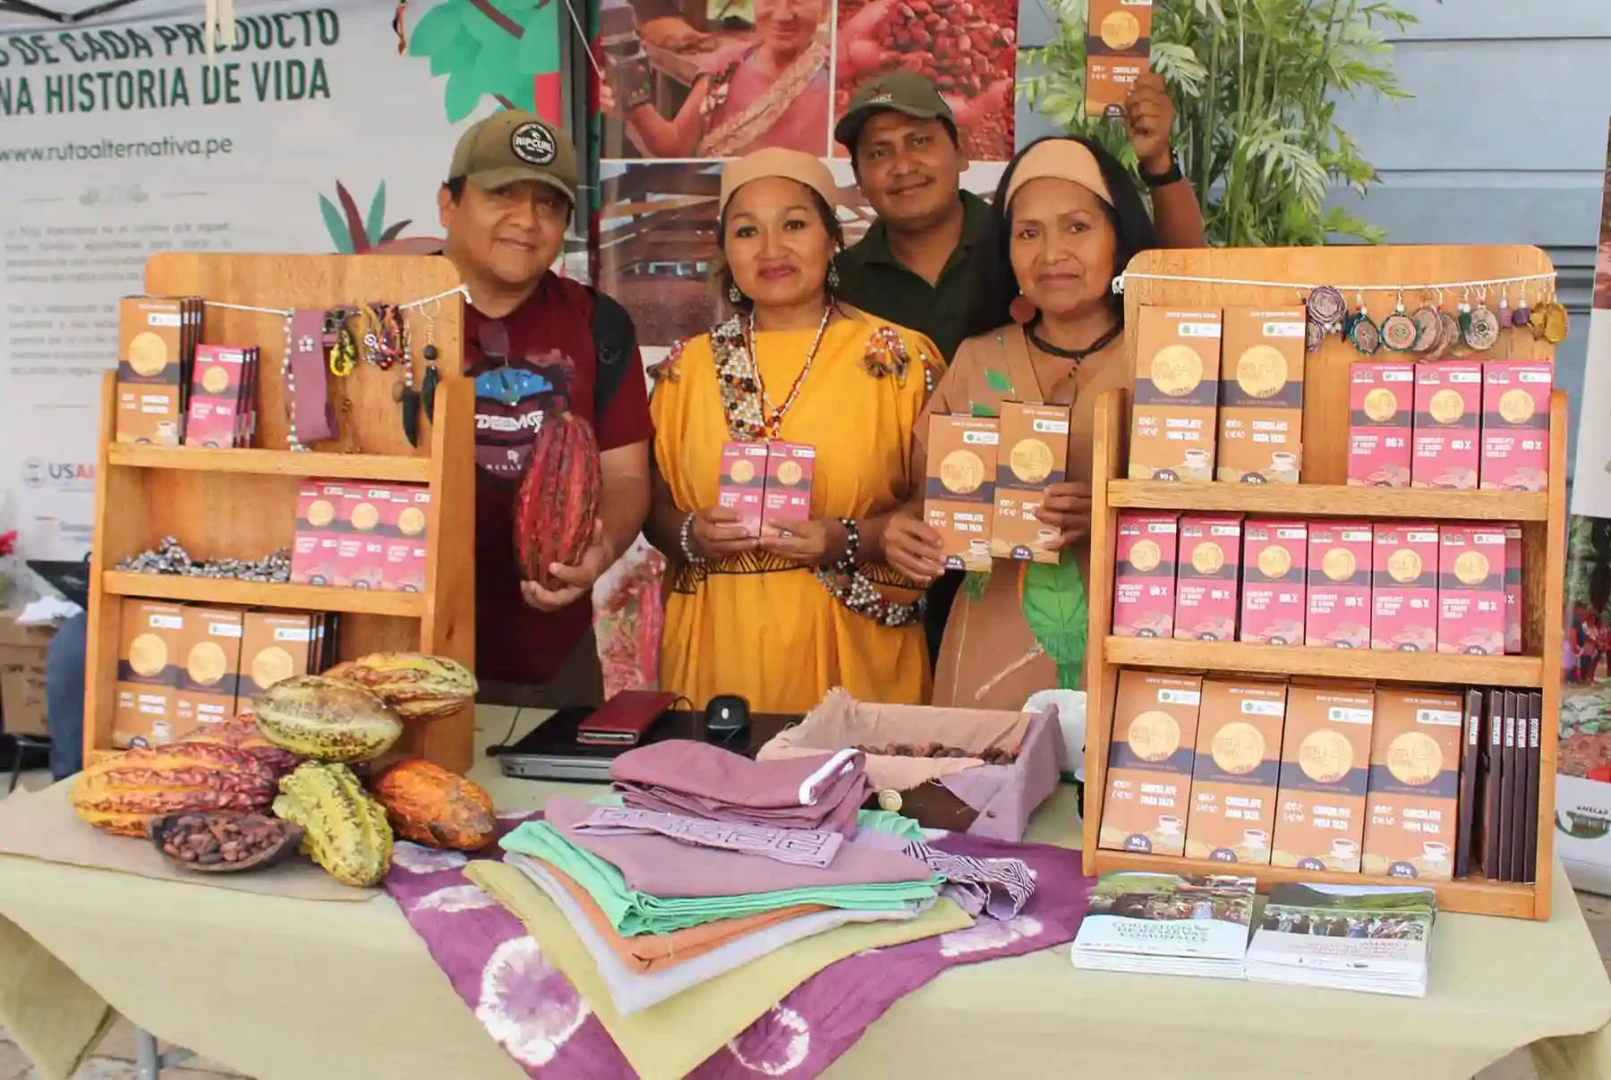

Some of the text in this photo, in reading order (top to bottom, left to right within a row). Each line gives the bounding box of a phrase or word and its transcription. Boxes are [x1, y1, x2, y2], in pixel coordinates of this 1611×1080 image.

[9, 36, 60, 66] DE
[58, 28, 154, 62] CADA
[45, 66, 190, 115] HISTORIA
[202, 63, 242, 105] DE
[251, 57, 331, 102] VIDA
